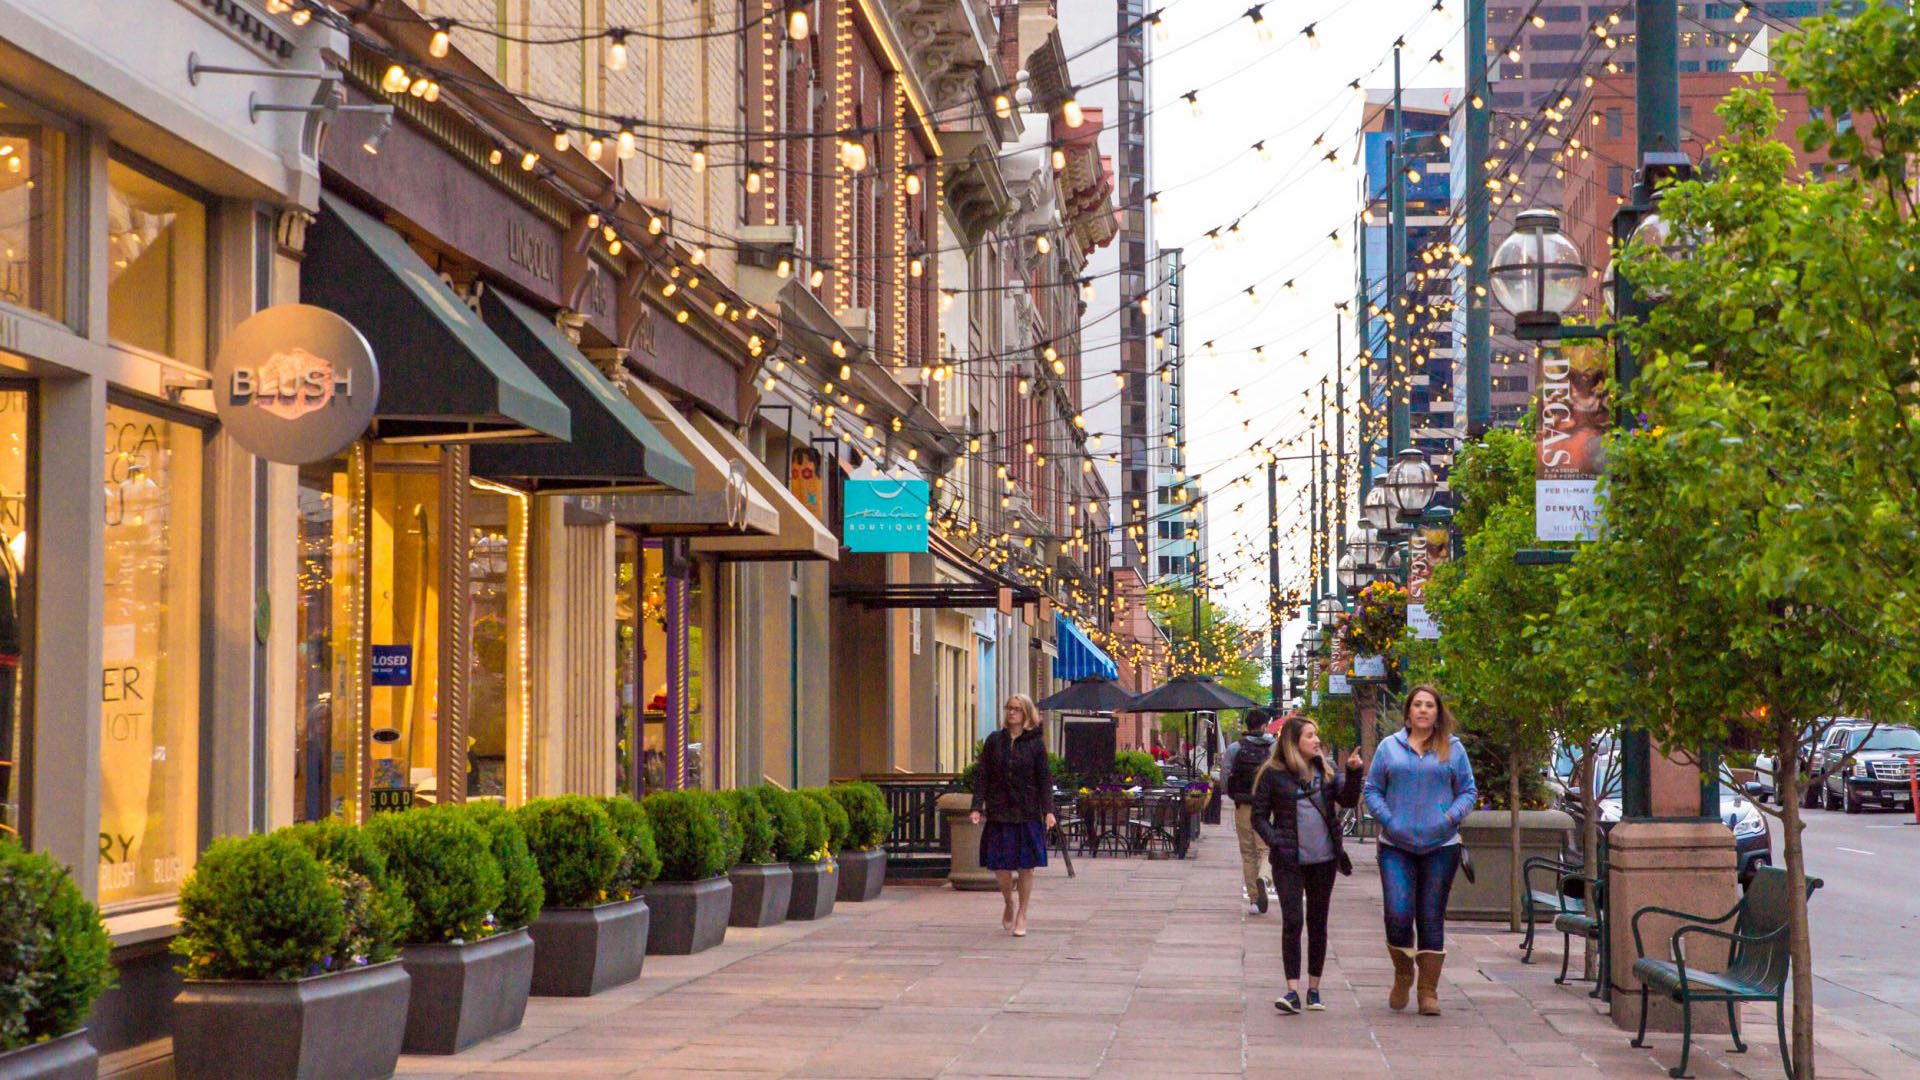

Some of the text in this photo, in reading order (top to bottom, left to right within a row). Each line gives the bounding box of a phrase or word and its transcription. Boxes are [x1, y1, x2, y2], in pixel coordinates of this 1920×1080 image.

[231, 366, 353, 397] BLUSH
[1542, 358, 1571, 467] DEGAS
[372, 655, 408, 666] LOSED
